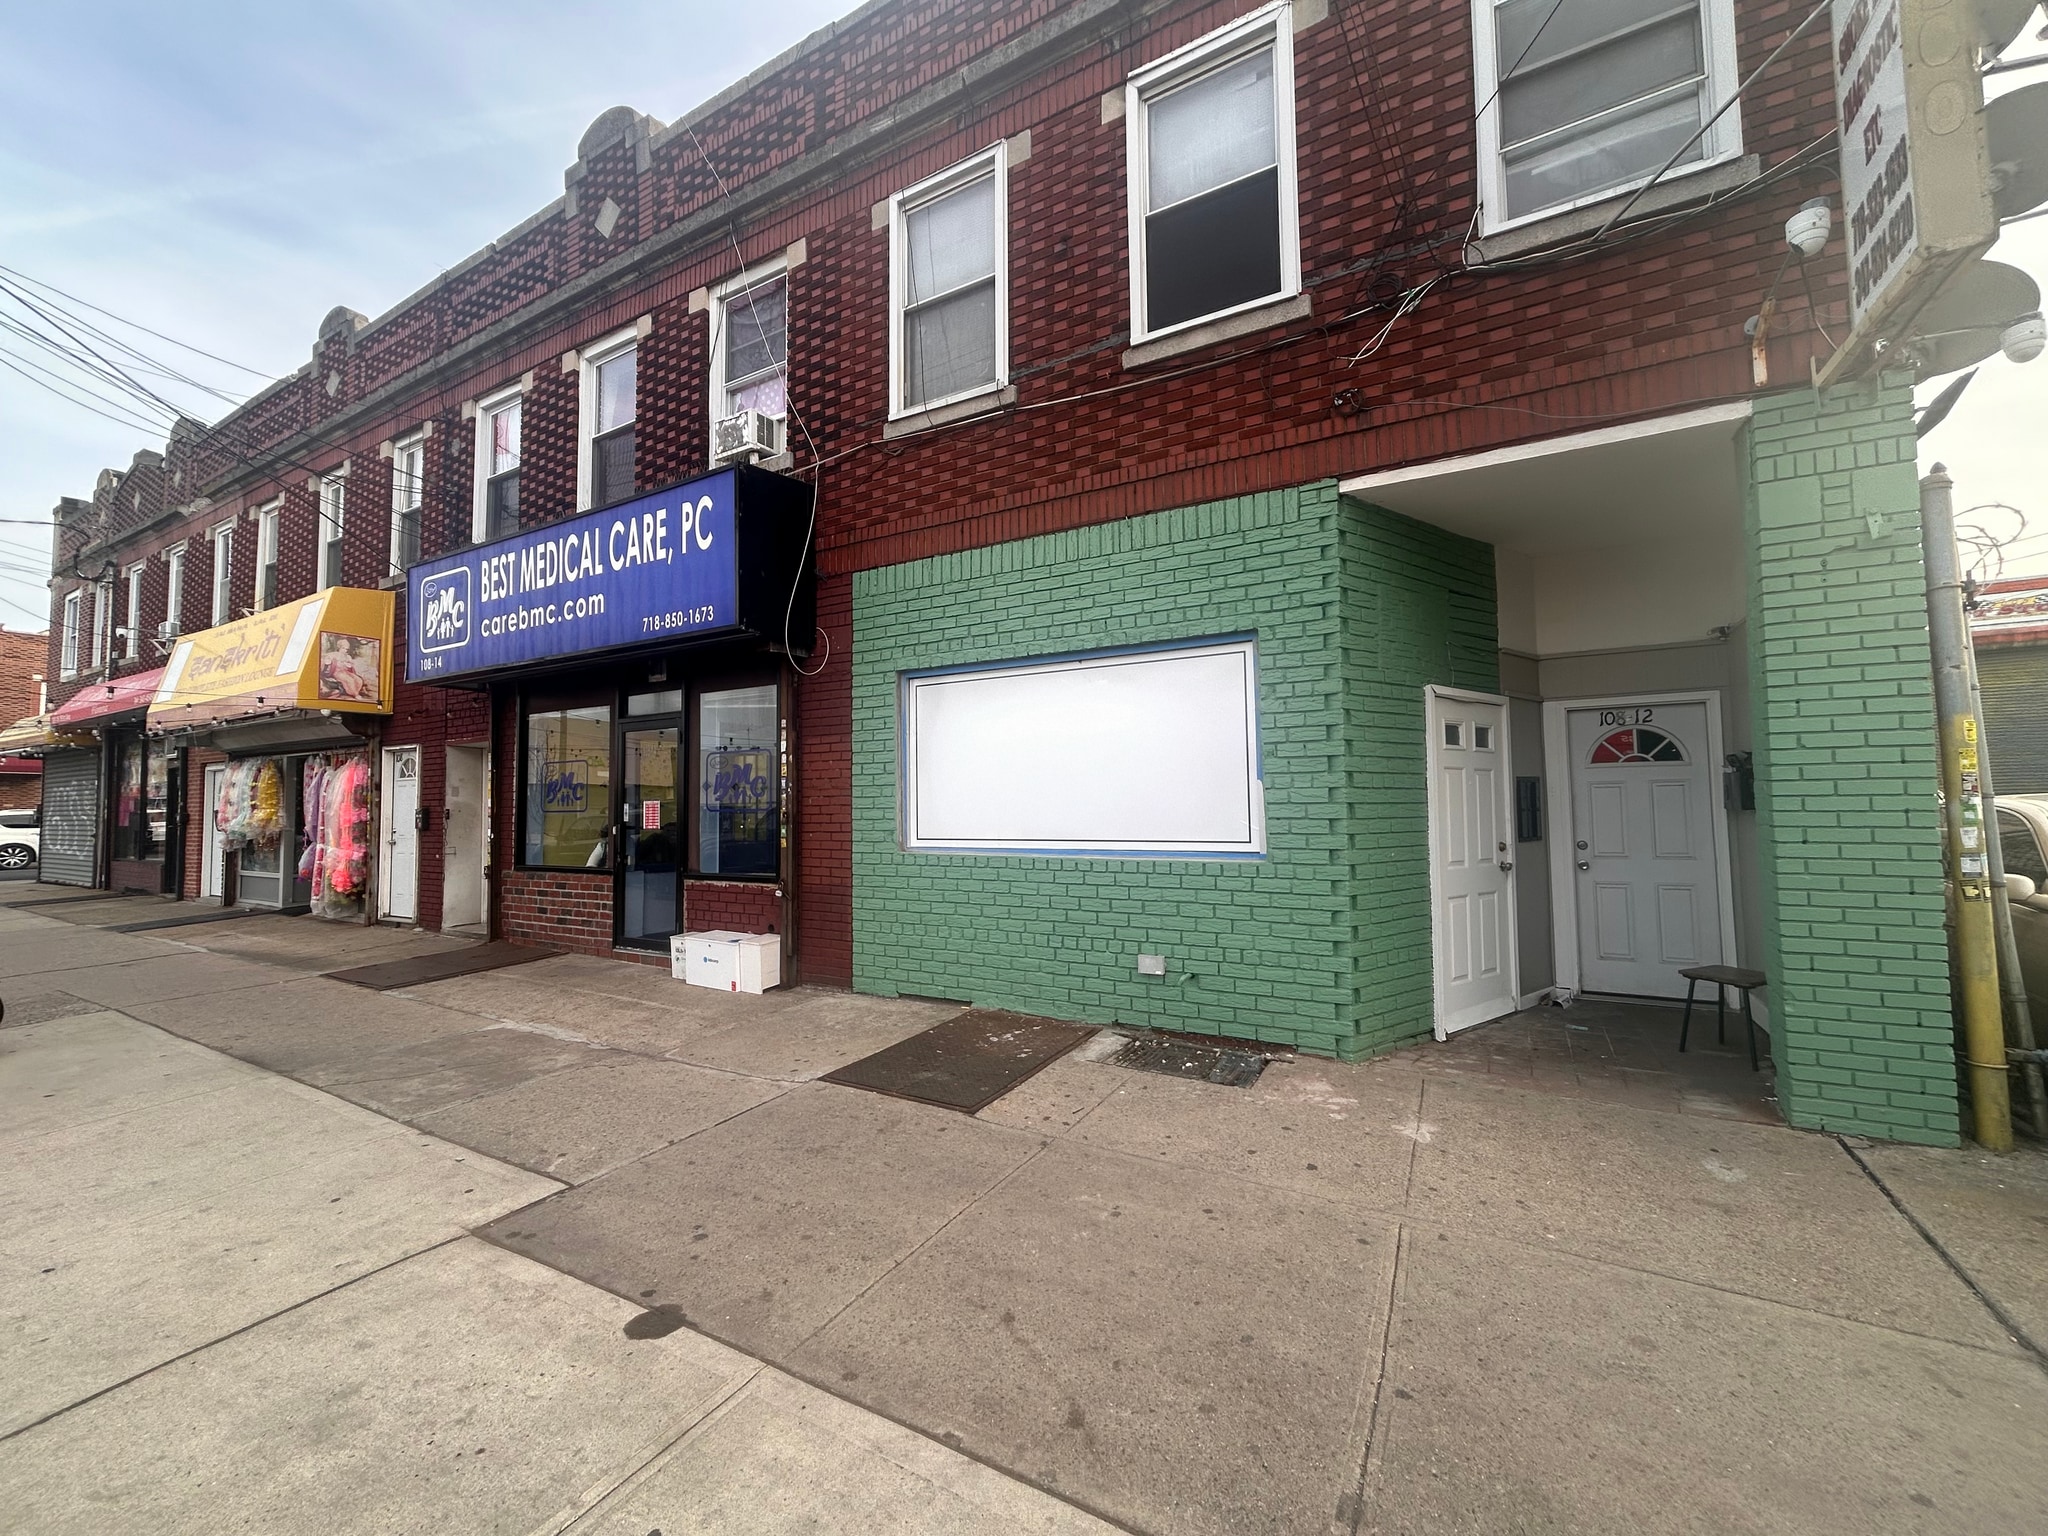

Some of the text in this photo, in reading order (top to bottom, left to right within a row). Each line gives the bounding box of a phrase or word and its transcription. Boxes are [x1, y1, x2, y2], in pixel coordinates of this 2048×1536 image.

[481, 495, 713, 603] BEST MEDICAL CARE, PC
[426, 586, 465, 638] BMC
[481, 592, 605, 637] carebmc.com
[642, 605, 714, 632] 718-850-1673
[420, 656, 442, 671] 108-14
[1599, 708, 1654, 726] 108-12
